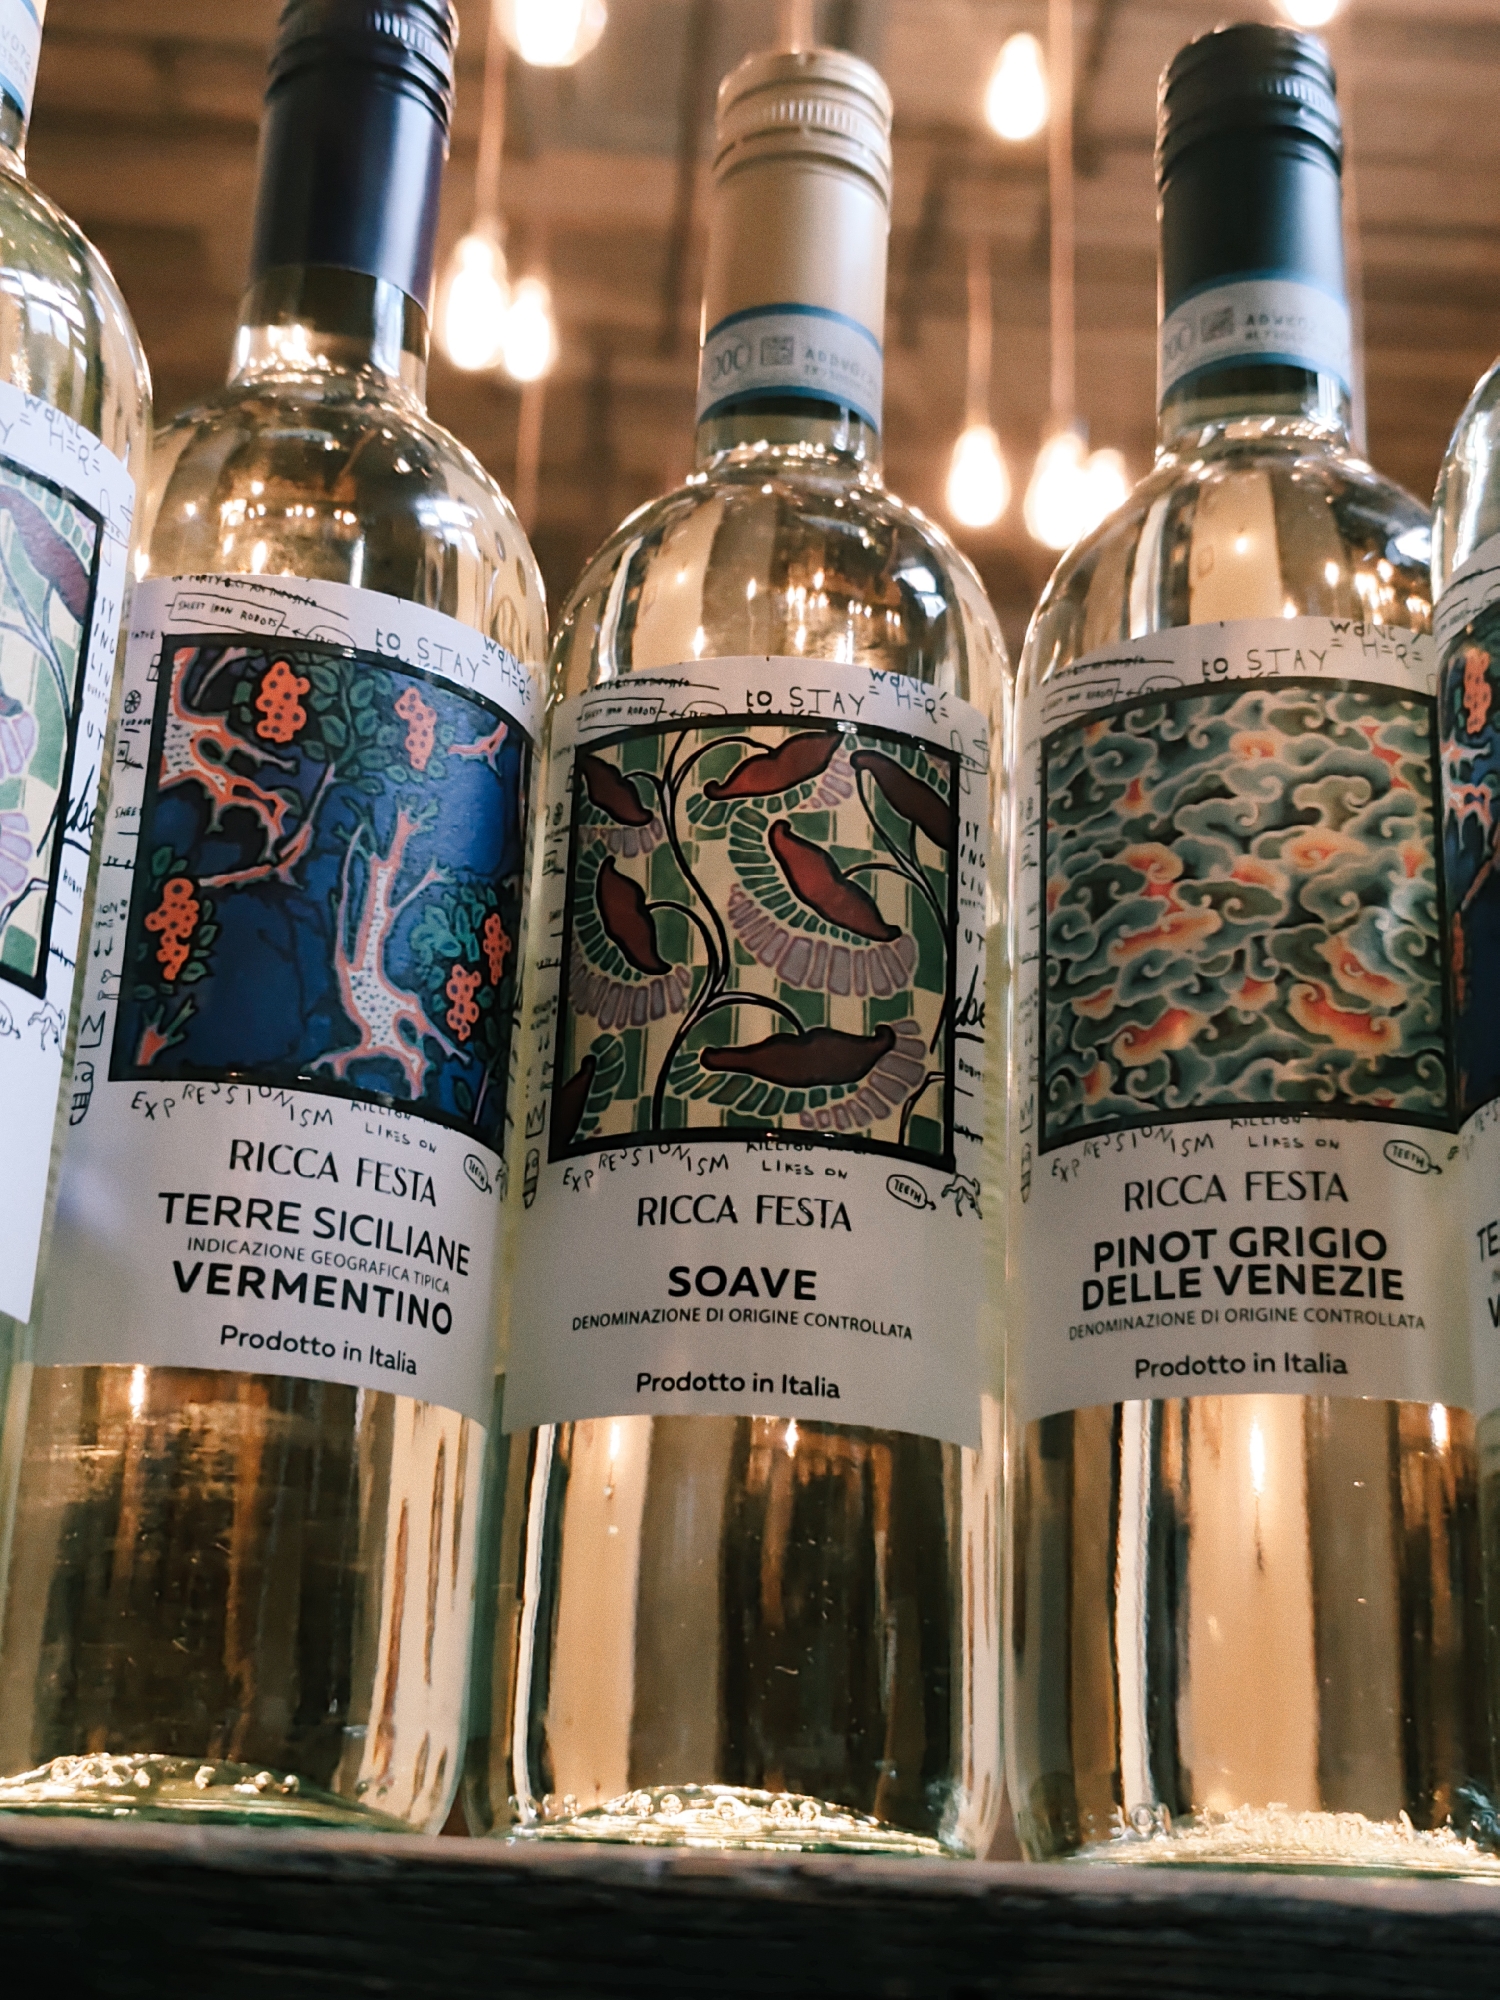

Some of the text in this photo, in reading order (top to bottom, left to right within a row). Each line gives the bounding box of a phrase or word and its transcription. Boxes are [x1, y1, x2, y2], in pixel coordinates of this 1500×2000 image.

[229, 1139, 437, 1207] RICCA FESTA
[1124, 1171, 1349, 1212] RICCA FESTA
[158, 1192, 471, 1276] TERRE SICILIANE
[636, 1194, 852, 1232] RICCA FESTA
[187, 1237, 450, 1295] INDICAZIONE GEOGRAFICA TIPICA
[1094, 1226, 1388, 1273] PINOT GRIGIO
[172, 1260, 453, 1336] VERMENTINO
[667, 1265, 817, 1301] SOAVE
[1082, 1264, 1404, 1311] DELLE VENEZIE
[572, 1307, 913, 1341] DENOMINAZIONE DI ORIGINE CONTROLLATA
[1068, 1307, 1426, 1341] DENOMINAZIONE DI ORIGINE CONTROLLATA
[220, 1325, 417, 1376] Prodotto in Italia
[1135, 1352, 1348, 1379] Prodotto in Italia
[636, 1371, 840, 1400] Prodotto in Italia
